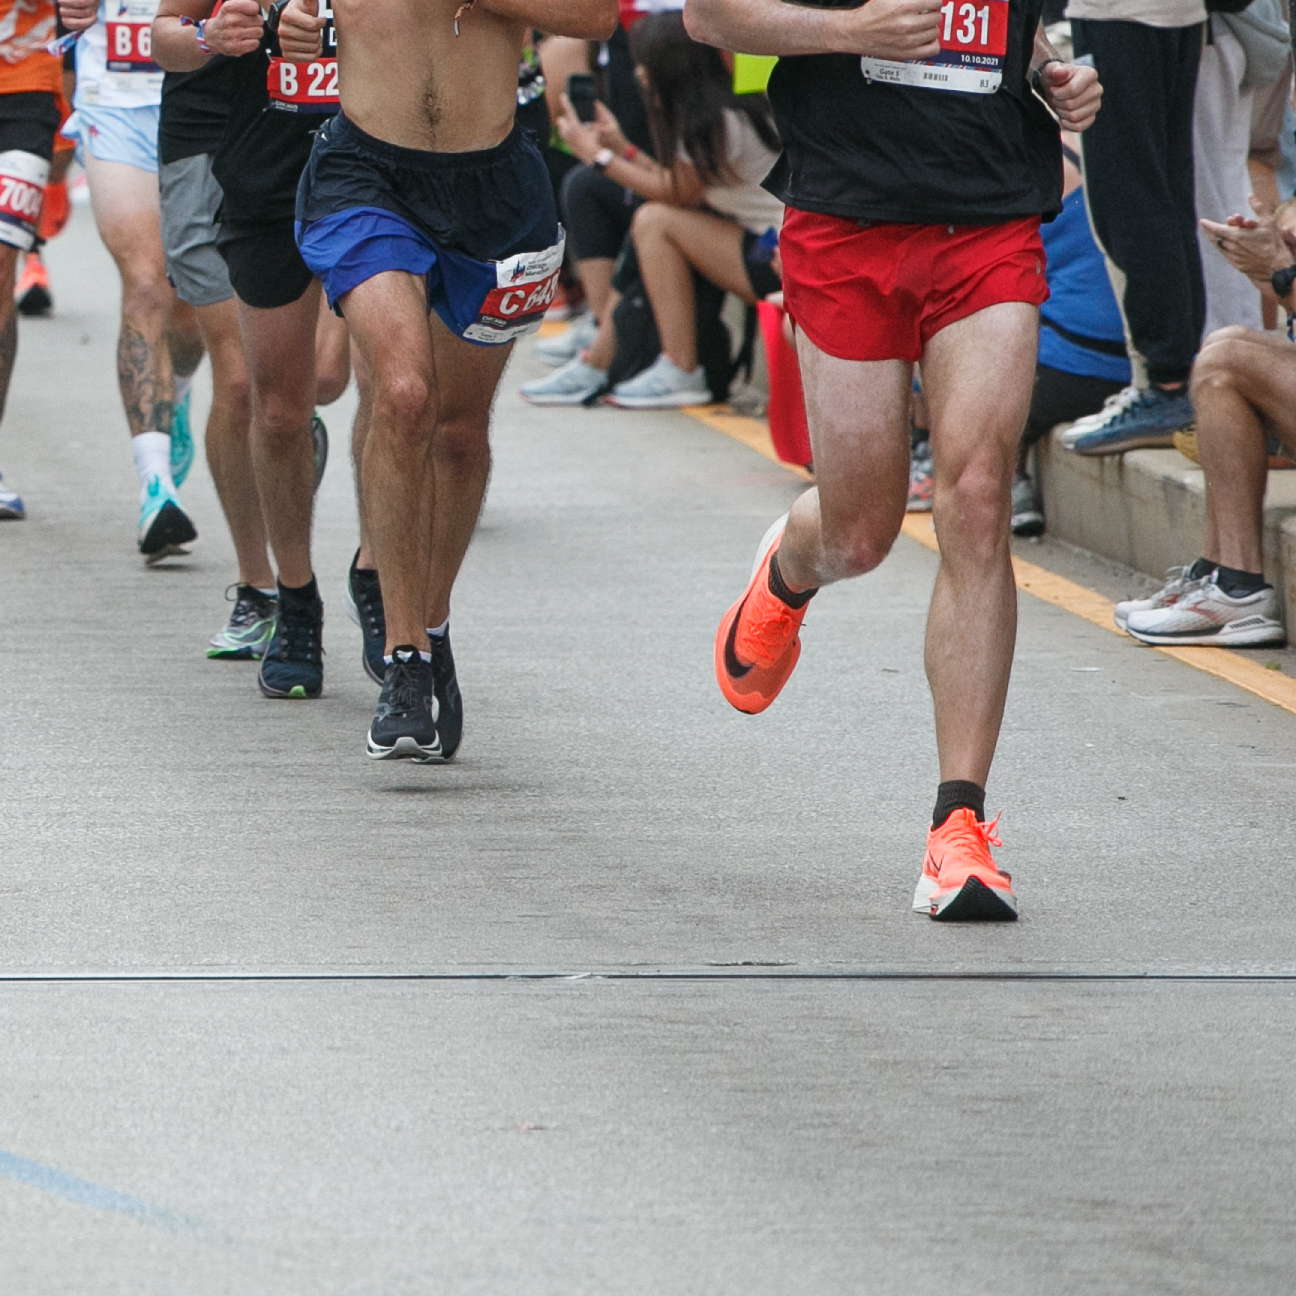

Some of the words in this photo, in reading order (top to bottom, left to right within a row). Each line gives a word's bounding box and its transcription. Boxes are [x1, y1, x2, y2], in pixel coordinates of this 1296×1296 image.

[940, 0, 990, 46] 131
[114, 25, 133, 57] B
[960, 54, 999, 66] 10.10.2021
[279, 62, 299, 97] B
[306, 61, 340, 97] 22
[879, 68, 894, 76] Gate
[979, 79, 990, 88] 83
[499, 289, 526, 315] C
[482, 315, 507, 325] CHICAGO
